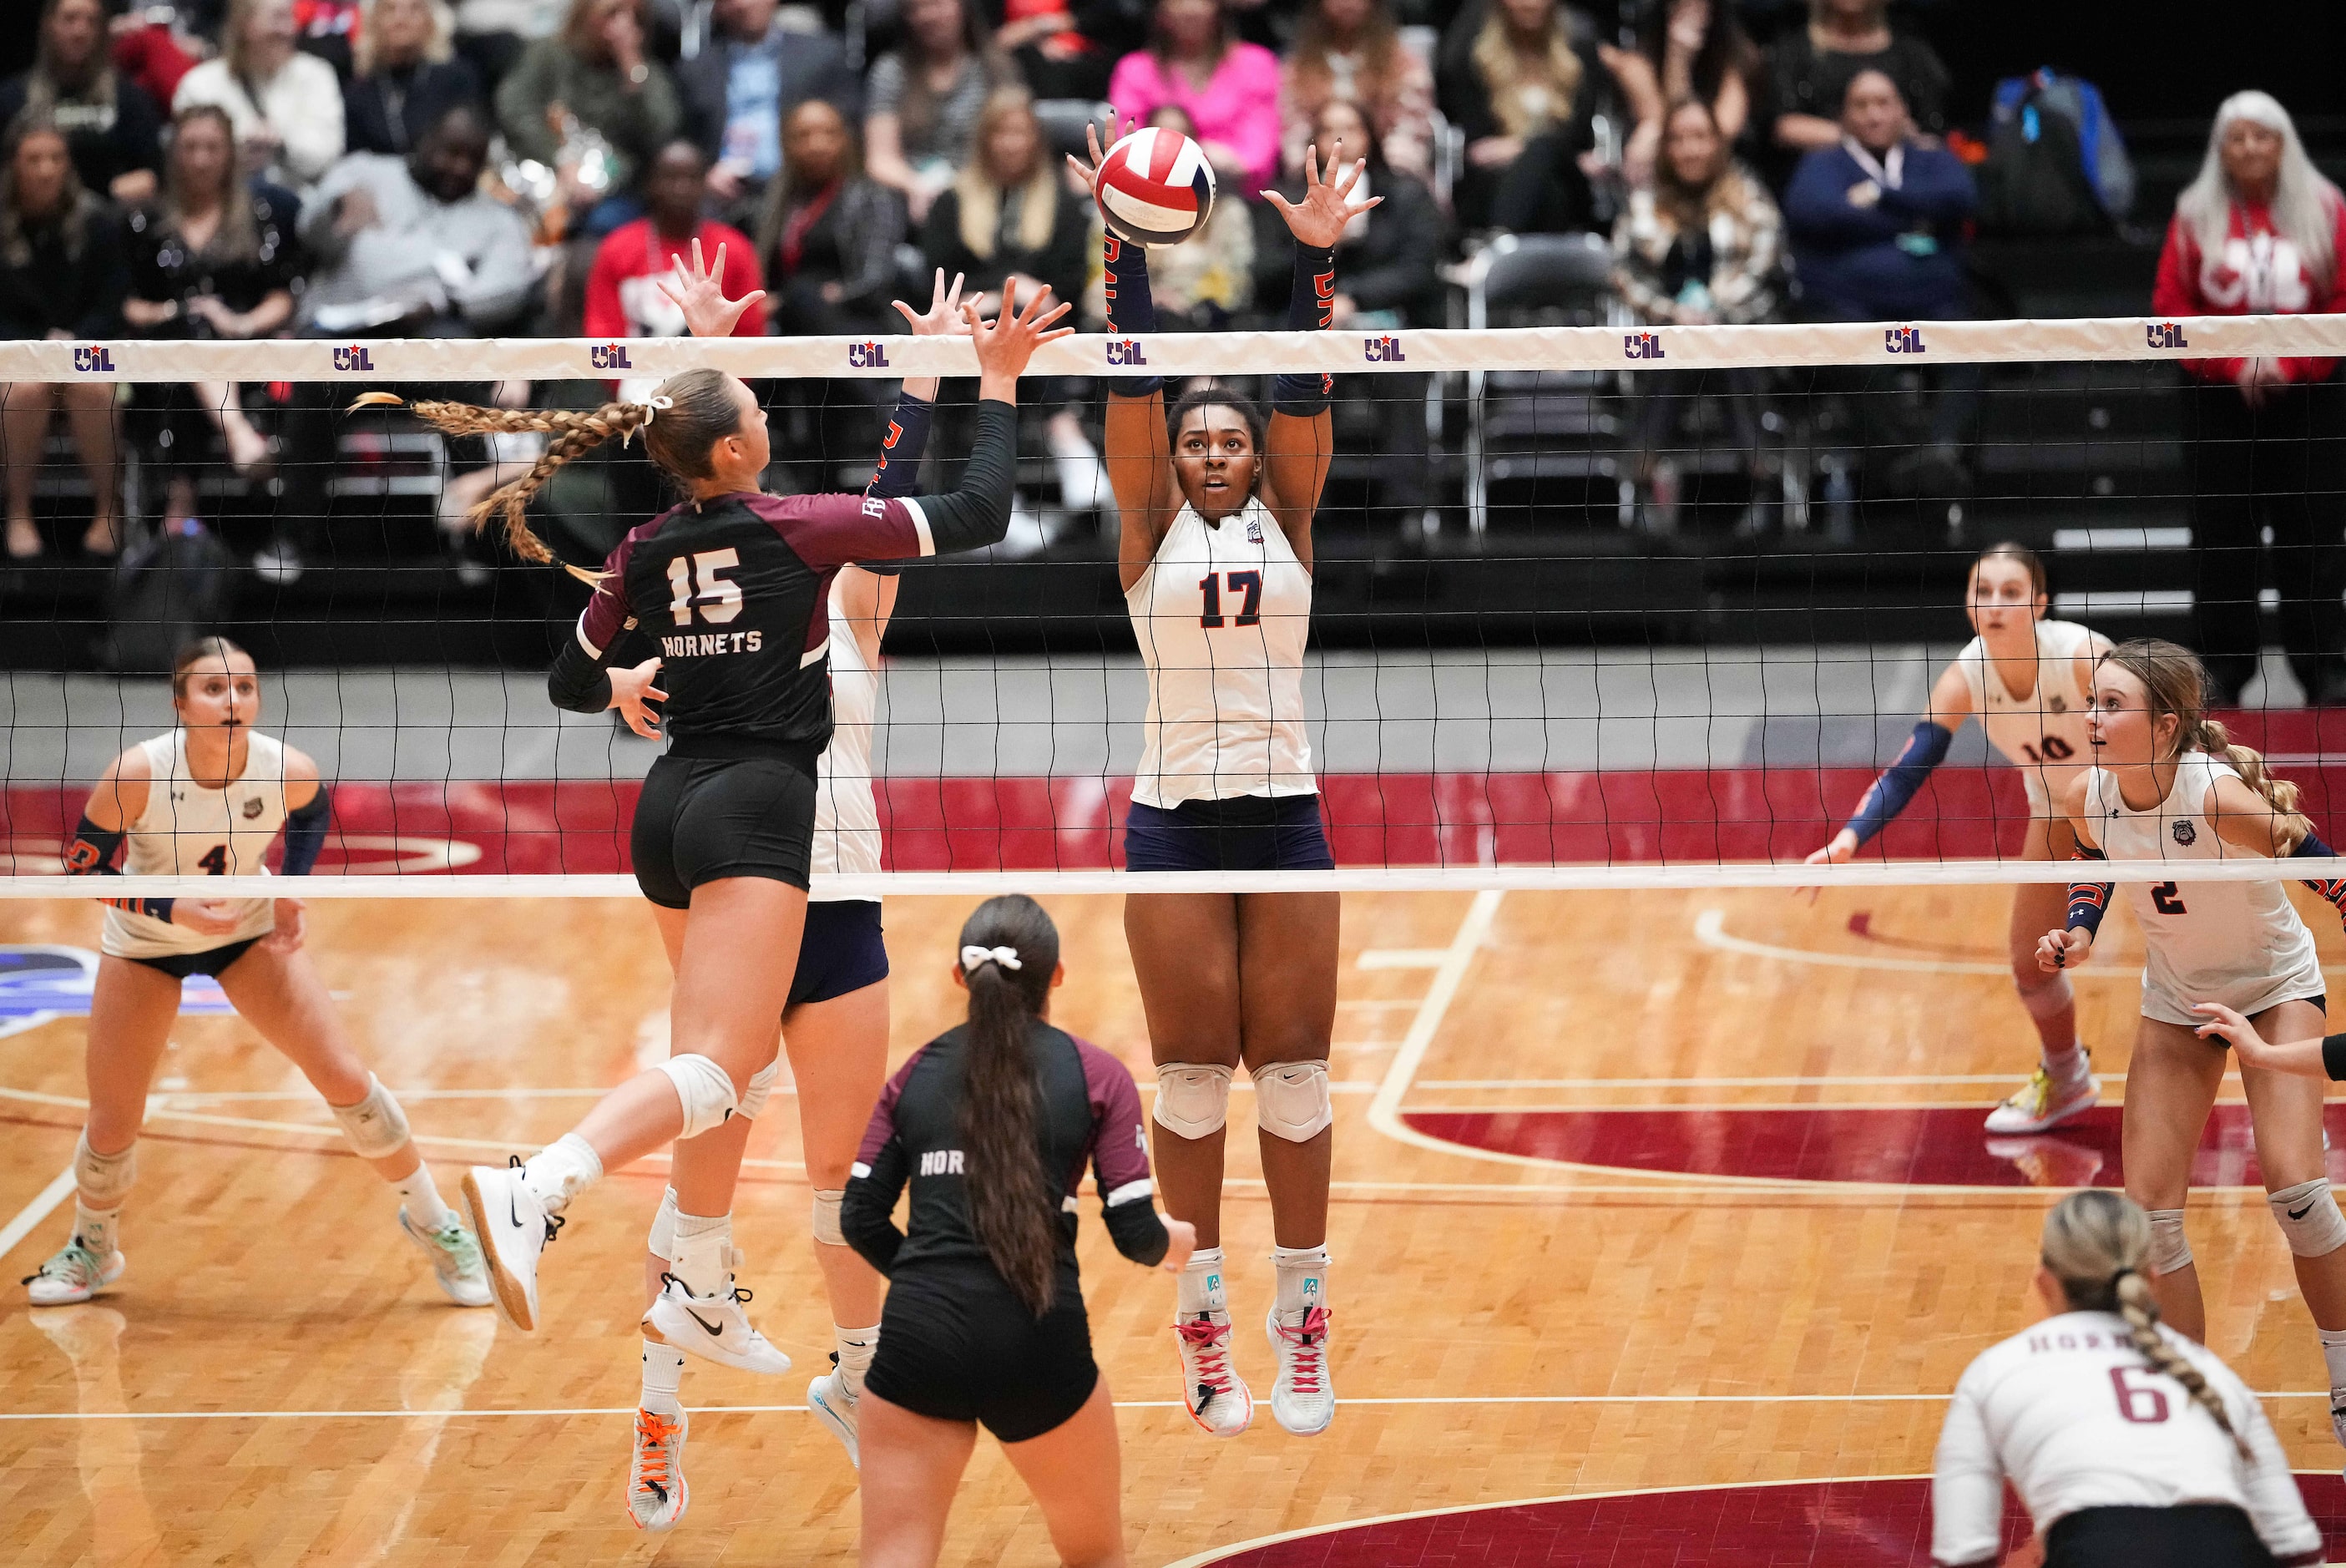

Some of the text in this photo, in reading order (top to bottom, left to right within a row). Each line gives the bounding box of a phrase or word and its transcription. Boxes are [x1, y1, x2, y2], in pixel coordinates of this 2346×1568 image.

[666, 546, 743, 627] 15
[1199, 569, 1262, 629] 17
[660, 630, 762, 658] HORNETS
[2021, 735, 2076, 763] 10
[197, 844, 228, 876] 4
[2147, 882, 2188, 915] 2
[920, 1150, 965, 1176] HOR
[2109, 1365, 2171, 1423] 6
